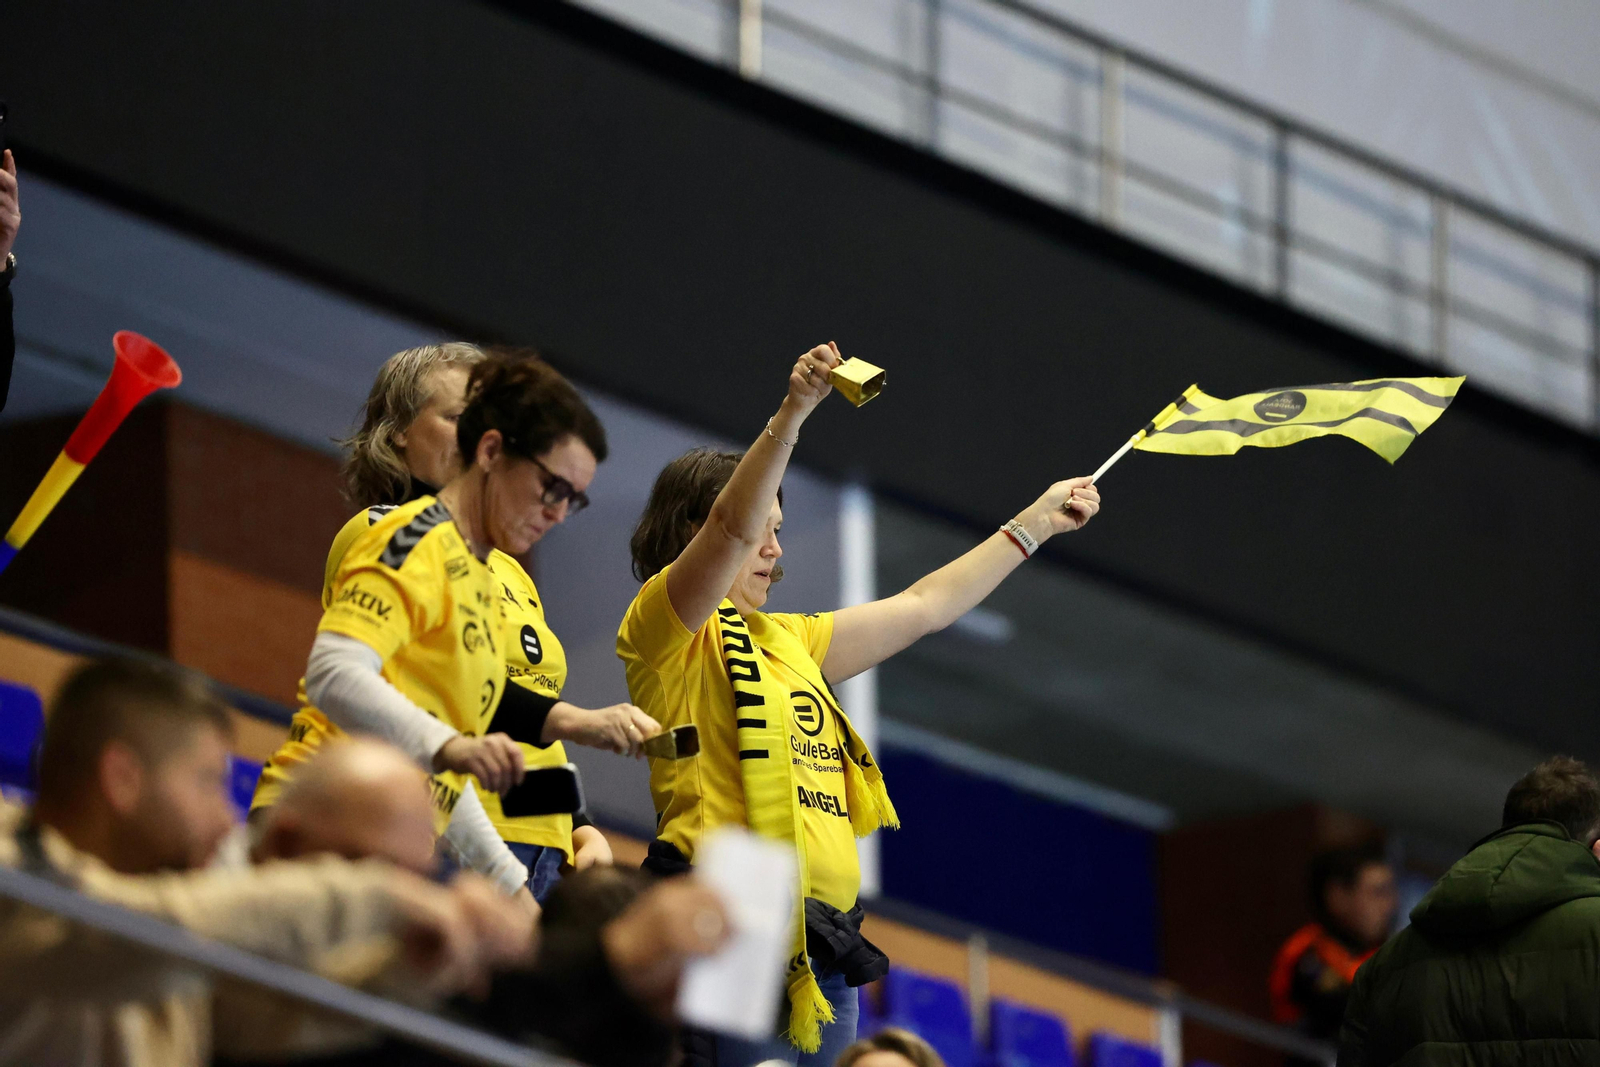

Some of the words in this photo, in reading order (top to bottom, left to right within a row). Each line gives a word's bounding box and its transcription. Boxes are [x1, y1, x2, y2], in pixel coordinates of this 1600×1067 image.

[790, 734, 844, 761] GuleBa
[812, 762, 844, 774] Spareba
[797, 785, 850, 818] ANGEL
